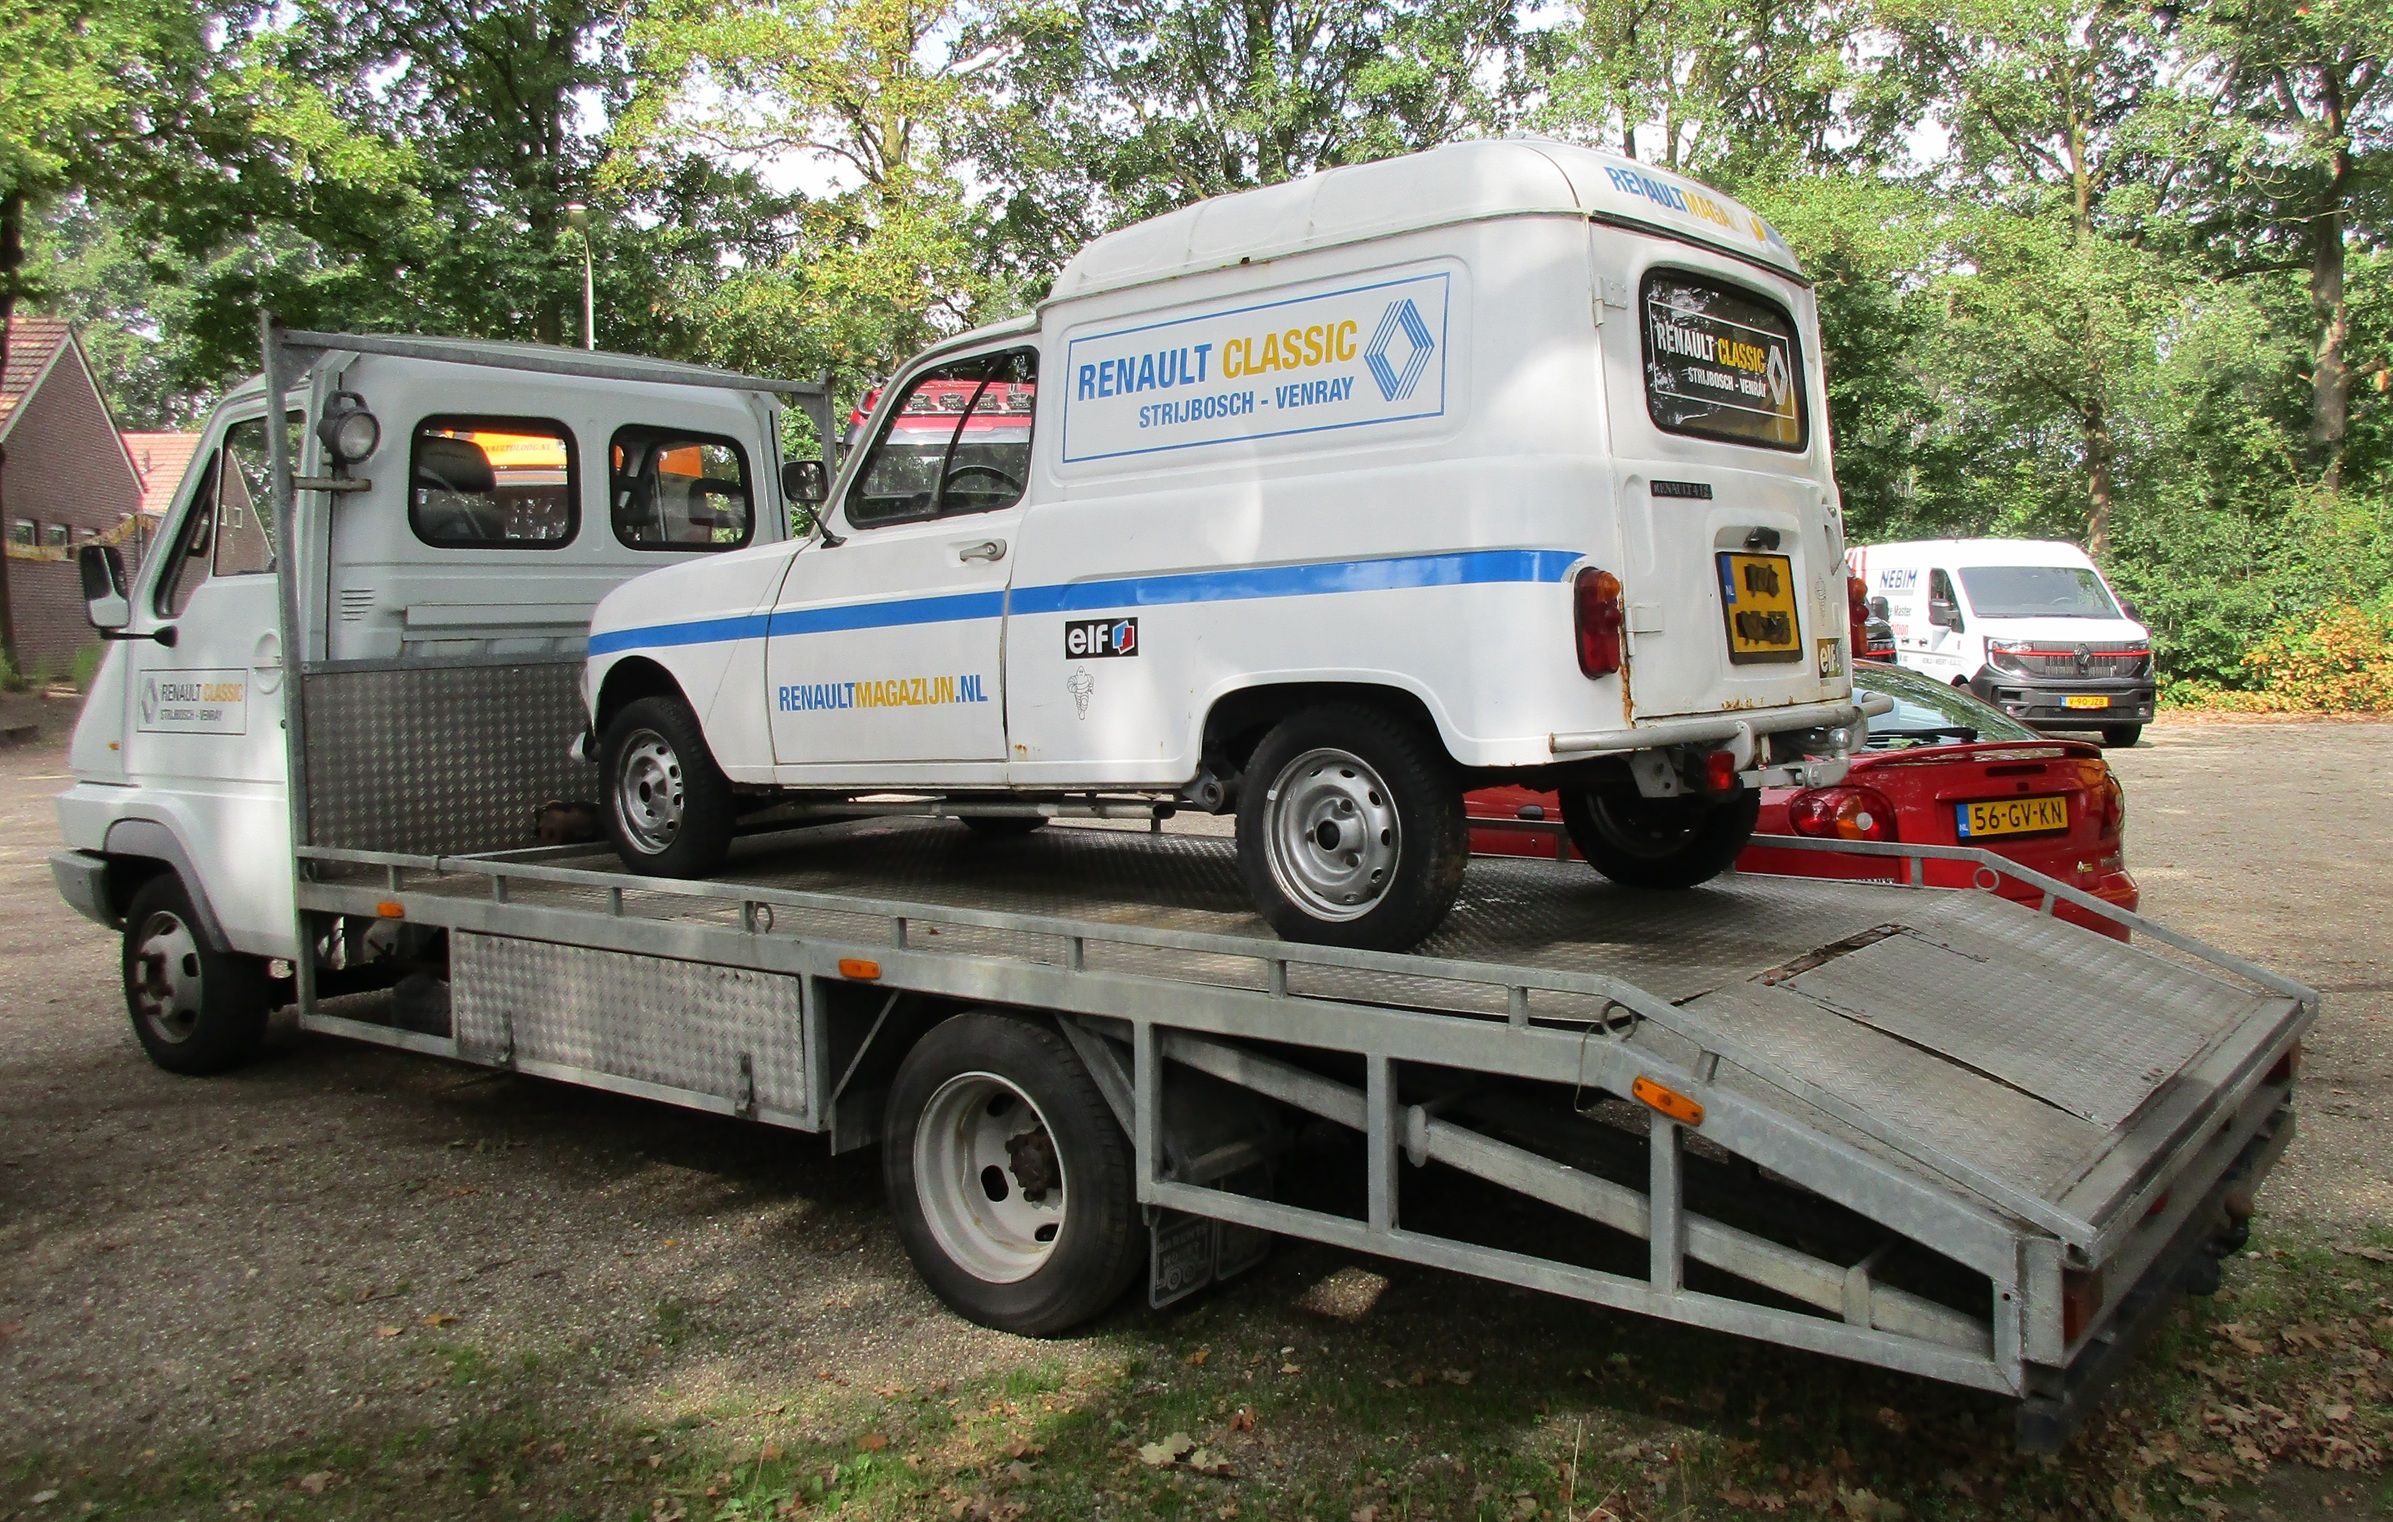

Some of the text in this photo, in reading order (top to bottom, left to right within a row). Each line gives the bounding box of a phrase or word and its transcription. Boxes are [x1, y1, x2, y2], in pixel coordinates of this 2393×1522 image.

[1077, 319, 1357, 401] RENAULT CLASSIC
[1656, 321, 1766, 374] RENAULT CLASSIC
[1687, 366, 1735, 392] STRIJBOSCH
[1139, 390, 1254, 429] STRIJBOSCH
[1275, 377, 1355, 410] VENRAY
[1725, 584, 1735, 596] NL
[1879, 569, 1918, 588] NEBIM
[1068, 624, 1109, 654] elf
[1819, 643, 1837, 673] elf
[162, 683, 243, 702] RENAULT CLASSIC
[779, 674, 988, 711] RENAULTMAGAZIJN.NL
[1974, 801, 2062, 831] 56-GV-KN
